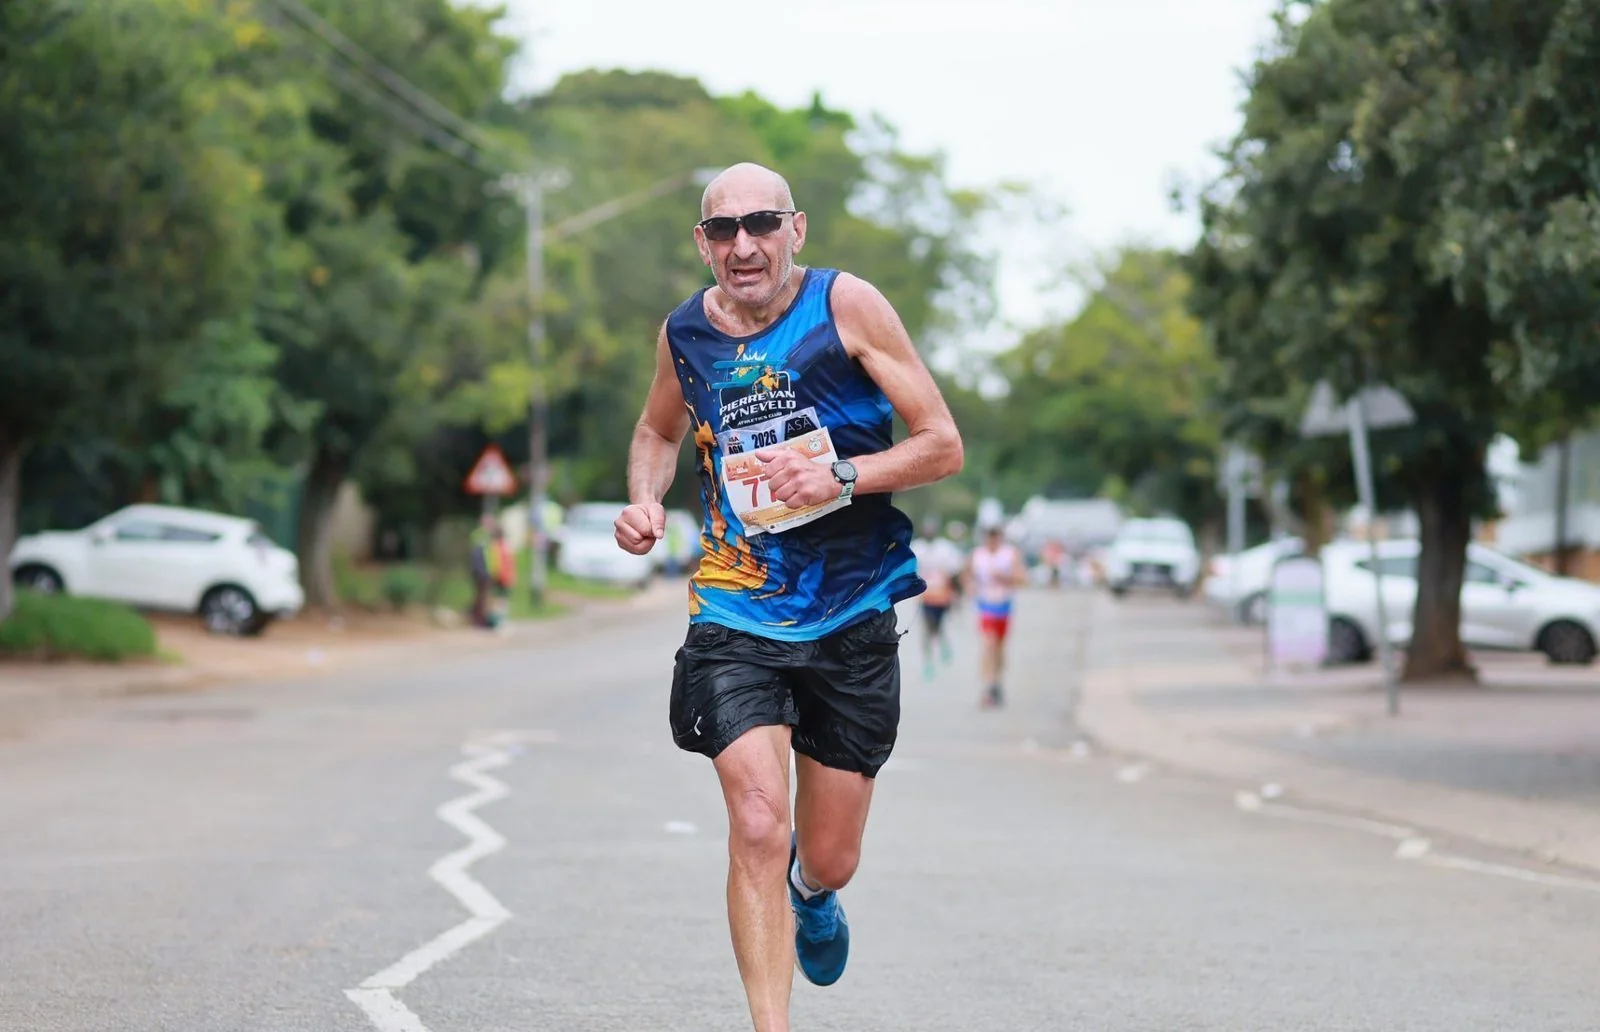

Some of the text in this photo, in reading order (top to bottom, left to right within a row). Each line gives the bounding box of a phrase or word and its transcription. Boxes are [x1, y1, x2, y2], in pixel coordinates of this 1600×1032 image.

[720, 390, 795, 416] PIERRE VAN
[721, 400, 796, 427] RYNEVELD
[787, 418, 812, 433] ASA
[751, 429, 778, 449] 2026
[728, 445, 744, 455] AGN
